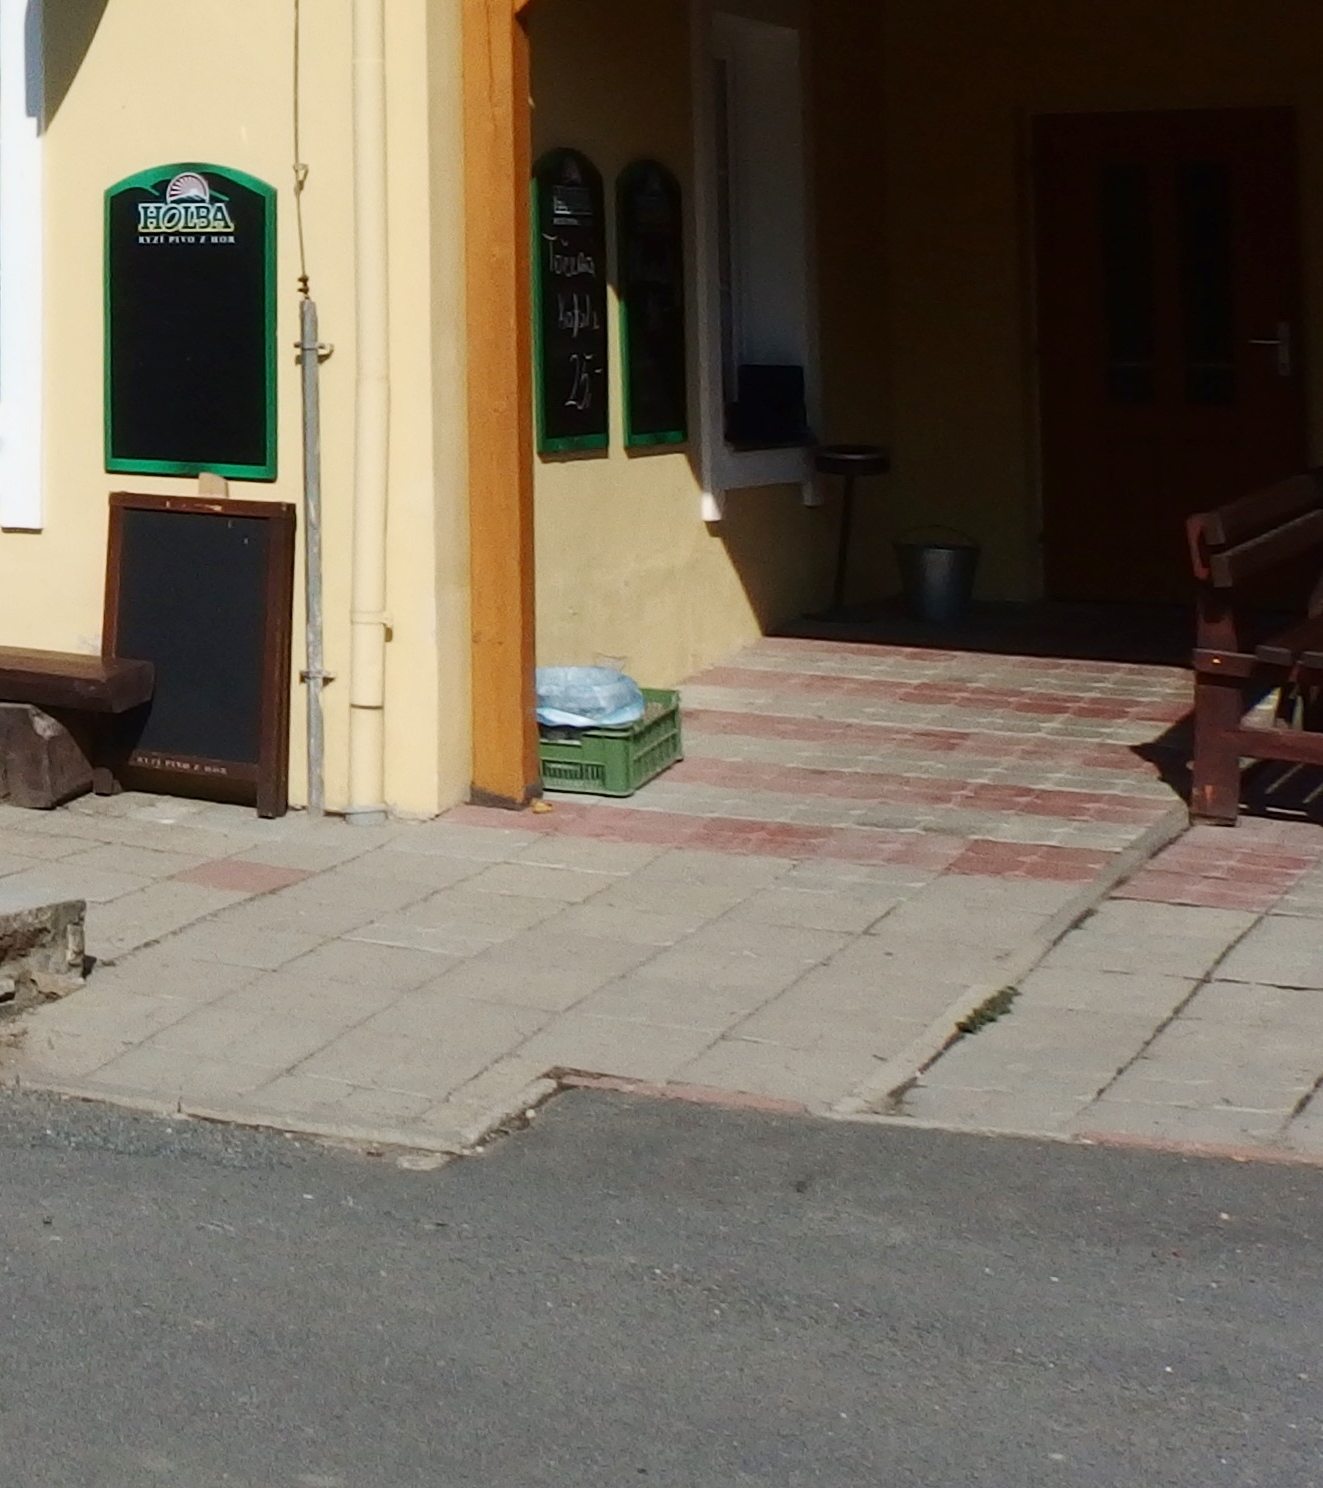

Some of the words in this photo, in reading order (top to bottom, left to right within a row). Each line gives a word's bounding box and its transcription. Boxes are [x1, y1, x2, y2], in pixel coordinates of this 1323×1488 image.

[138, 202, 235, 232] HOLBA
[168, 236, 195, 244] PIVO
[210, 236, 235, 244] HOR
